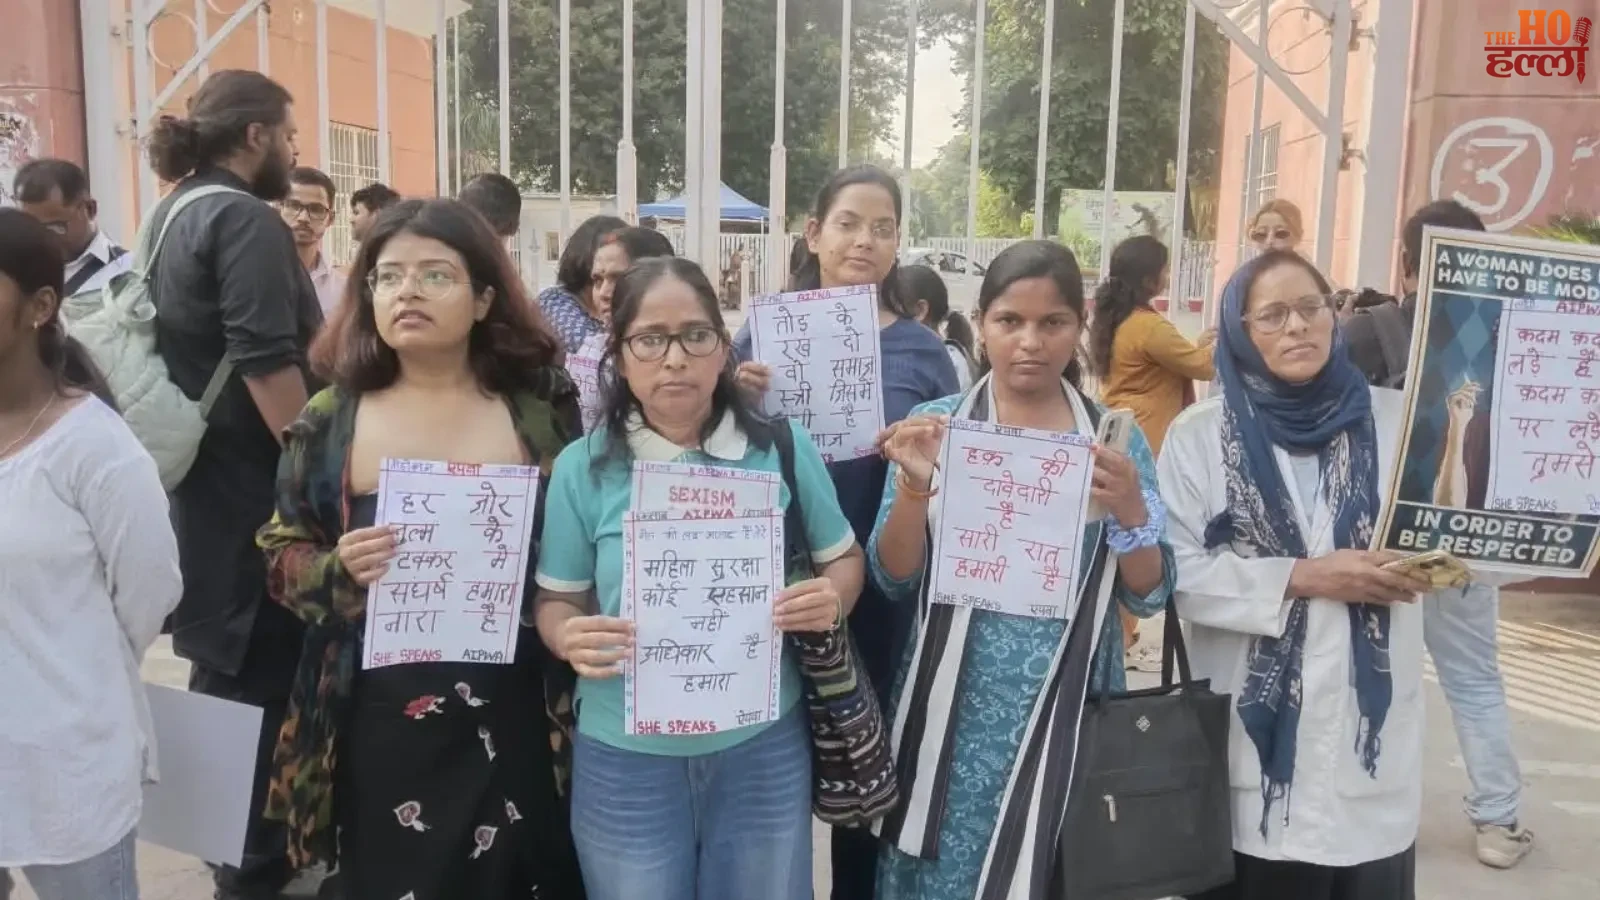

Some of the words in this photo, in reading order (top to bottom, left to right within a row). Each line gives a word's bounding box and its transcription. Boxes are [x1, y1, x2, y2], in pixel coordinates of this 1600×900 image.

[1452, 138, 1529, 215] 3
[1438, 251, 1450, 264] A
[1457, 252, 1534, 275] WOMAN
[1540, 264, 1591, 281] DOES
[1438, 269, 1488, 287] HAVE
[1494, 275, 1519, 291] TO
[1525, 279, 1549, 294] BE
[1510, 417, 1554, 438] पर
[1030, 448, 1078, 477] की
[396, 491, 446, 514] हर
[669, 485, 736, 508] SEXISM
[1517, 497, 1557, 510] SPEAKS
[682, 509, 735, 520] AIPWA
[1414, 510, 1441, 528] IN
[1450, 515, 1534, 540] ORDER
[1541, 525, 1573, 543] TO
[1399, 530, 1430, 548] BE
[1437, 534, 1575, 565] RESPECTED
[642, 550, 698, 578] महिला
[706, 557, 766, 582] सुरक्षा
[947, 556, 1010, 583] हमारी
[463, 581, 519, 606] हमारा
[642, 580, 688, 607] कोई
[961, 593, 1002, 610] SPEAKS
[376, 610, 446, 634] नारा
[373, 652, 394, 665] SHE
[400, 649, 442, 662] SPEAKS
[640, 638, 716, 665] अधिकार
[670, 672, 739, 693] हमारा
[637, 721, 661, 734] SHE
[668, 720, 716, 733] SPEAKS
